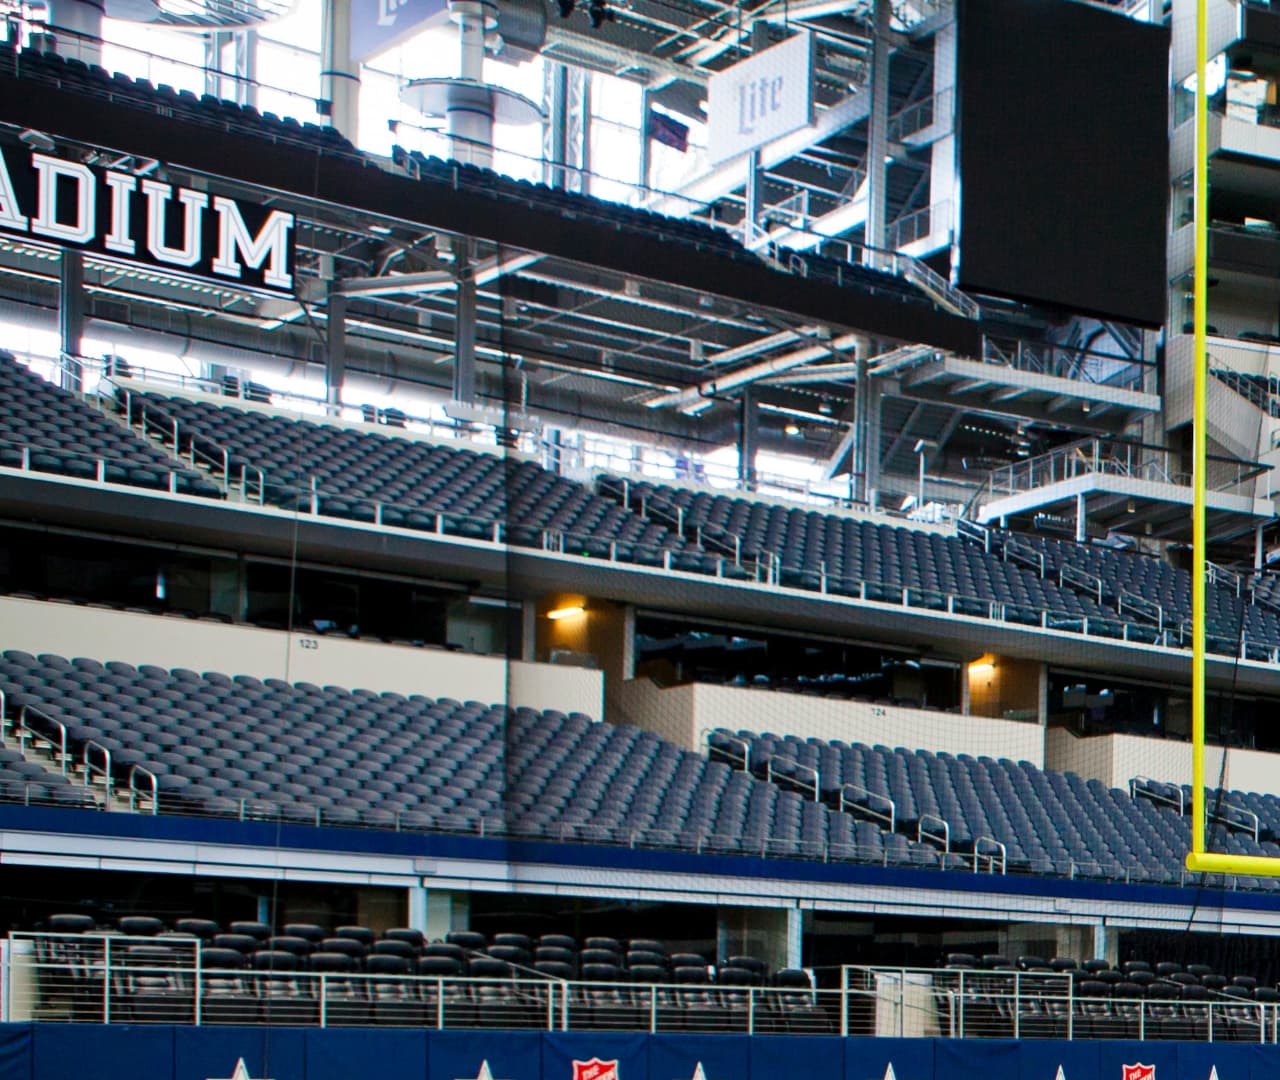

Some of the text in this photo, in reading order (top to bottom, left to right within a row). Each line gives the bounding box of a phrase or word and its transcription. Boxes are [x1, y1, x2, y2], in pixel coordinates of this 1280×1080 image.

[738, 76, 783, 134] Lite
[299, 639, 319, 650] 123
[871, 707, 887, 716] 124
[582, 1064, 600, 1080] THE
